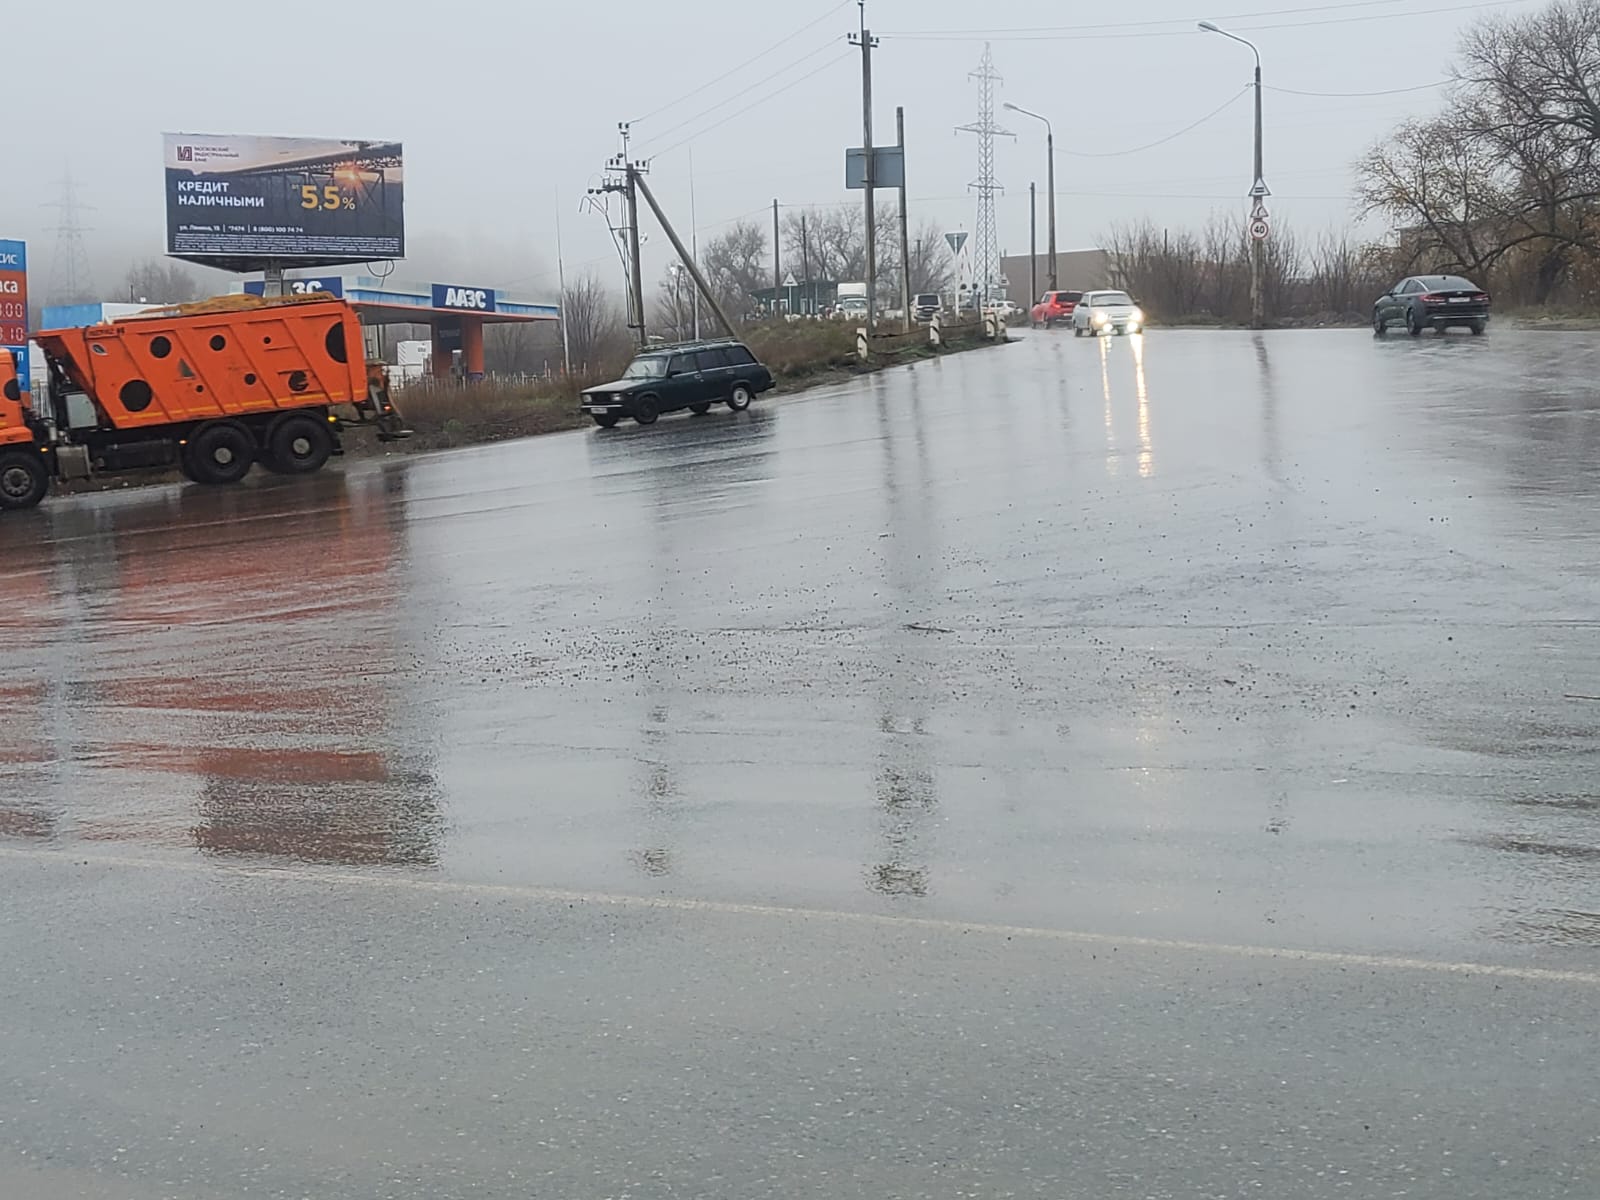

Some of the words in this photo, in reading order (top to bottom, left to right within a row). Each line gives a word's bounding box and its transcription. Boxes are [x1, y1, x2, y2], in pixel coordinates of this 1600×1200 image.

[178, 181, 230, 194] КРЕДИТ
[178, 196, 265, 208] НАЛИЧНЫМИ
[1254, 225, 1265, 234] 40
[445, 287, 487, 309] ААЗС
